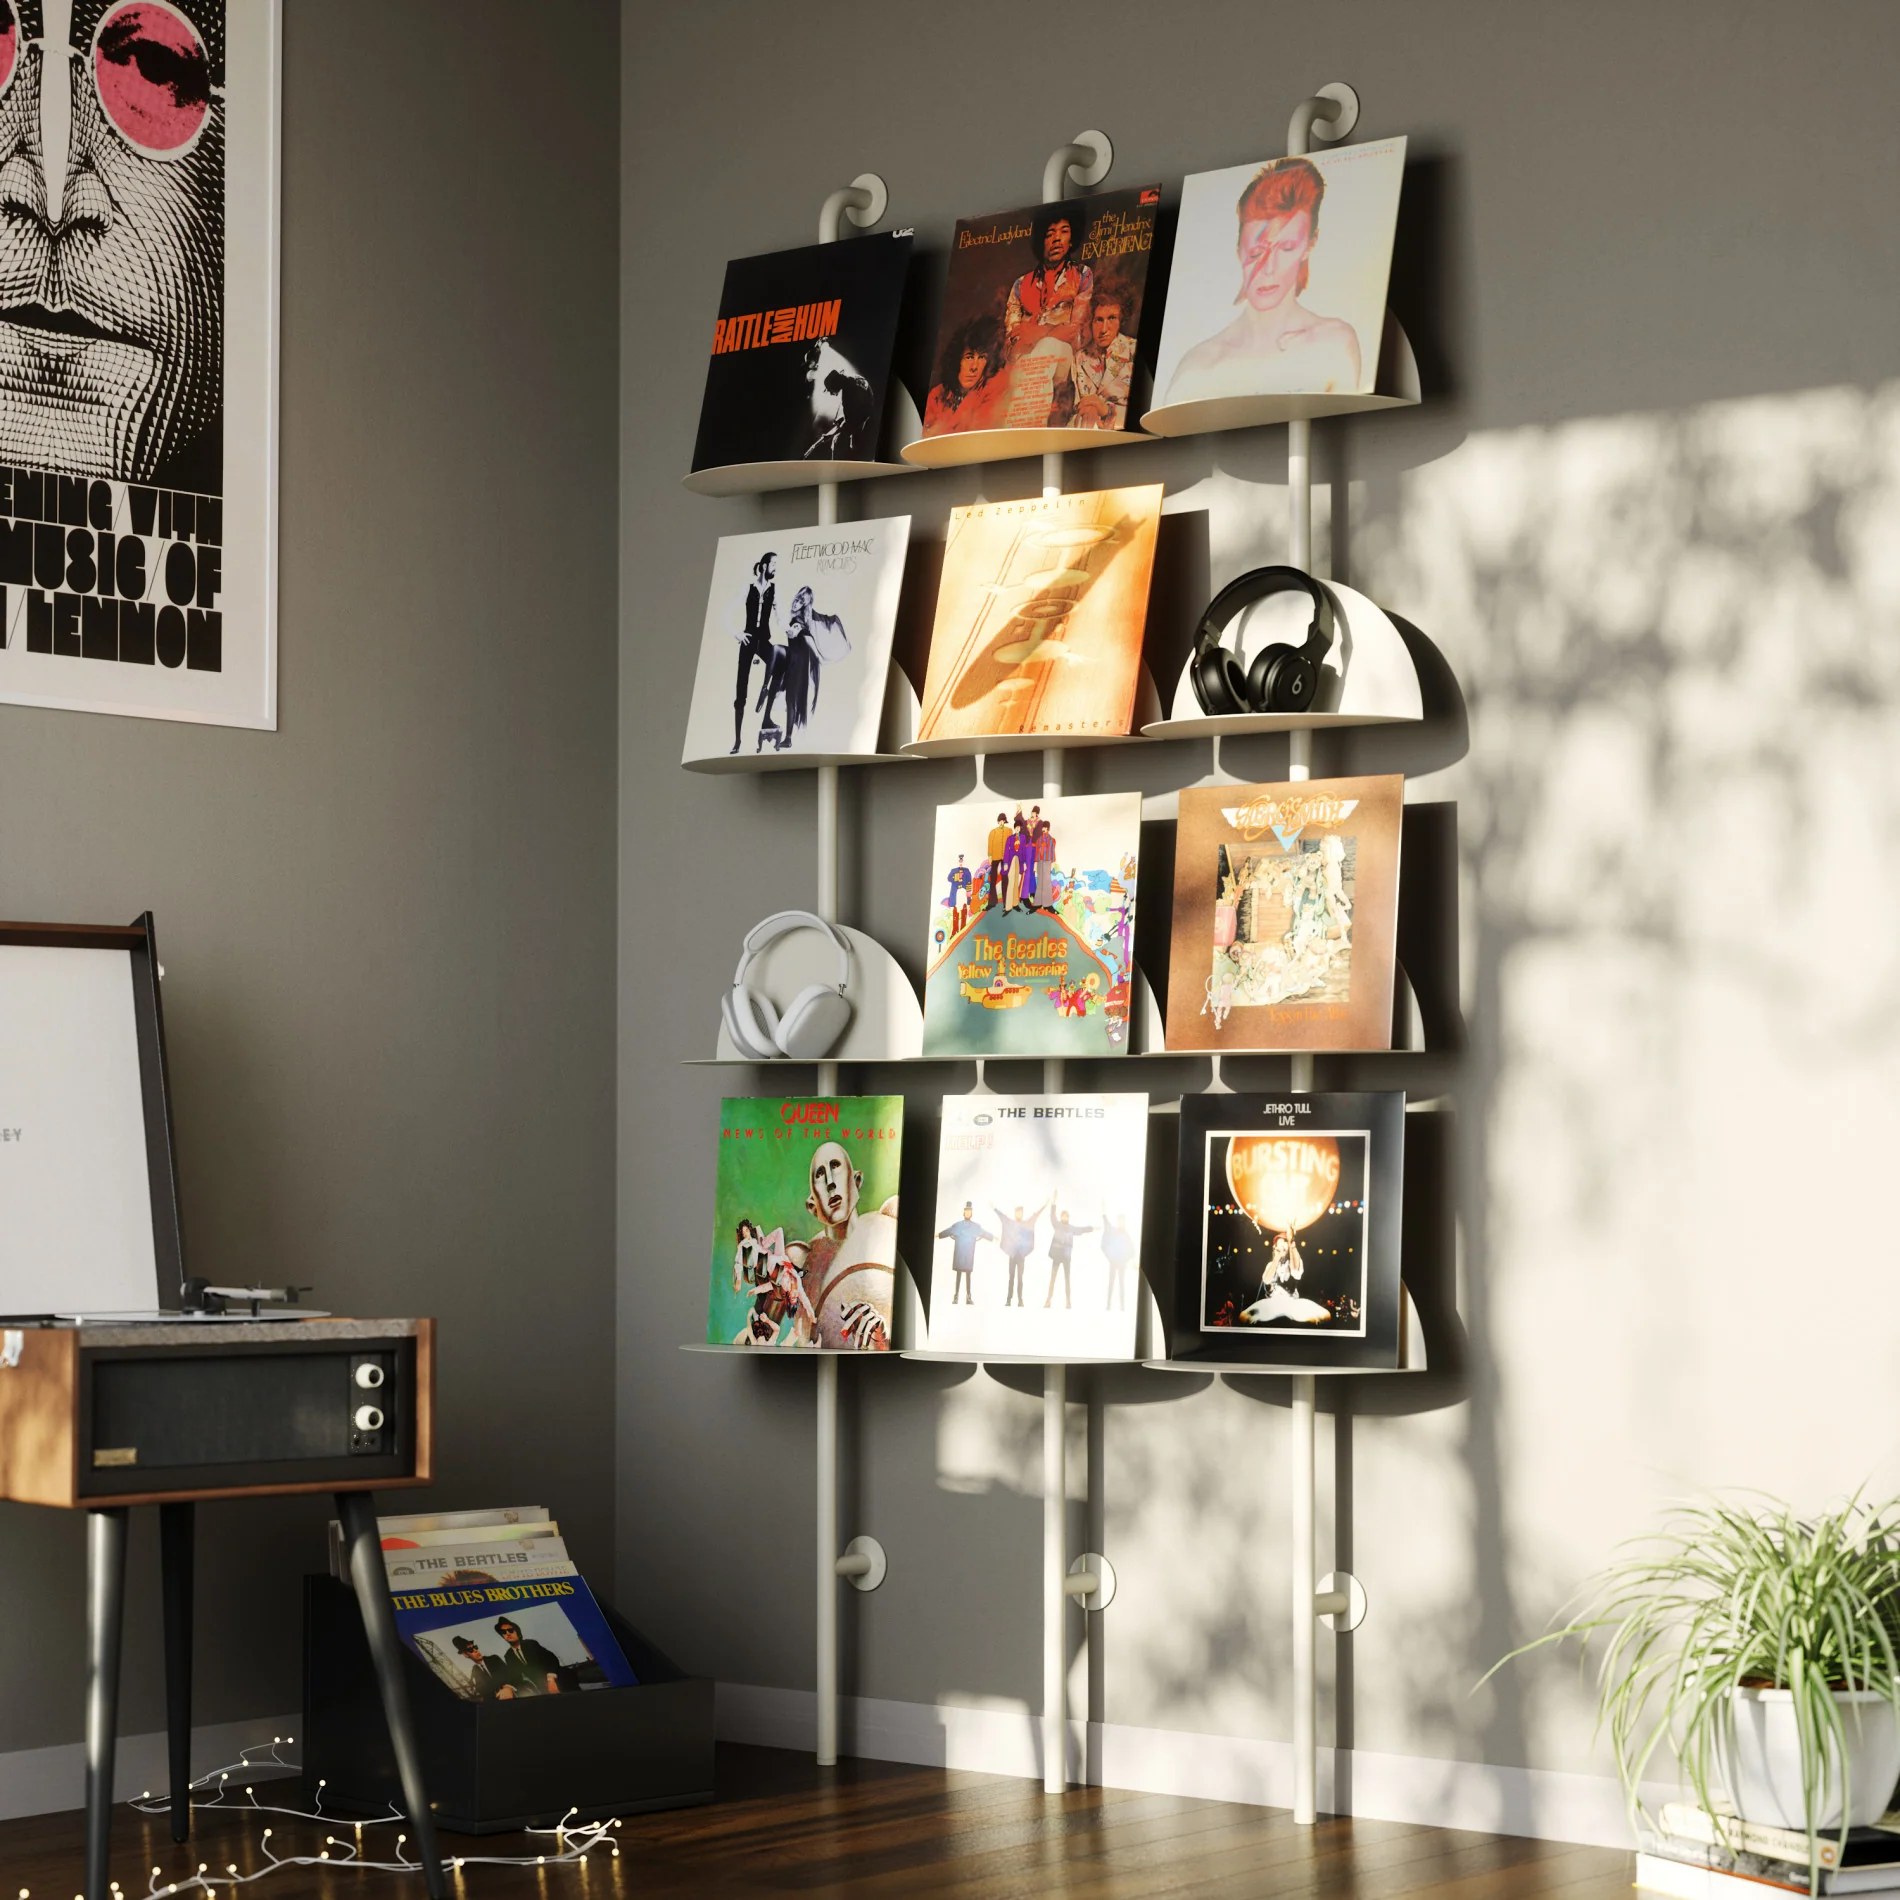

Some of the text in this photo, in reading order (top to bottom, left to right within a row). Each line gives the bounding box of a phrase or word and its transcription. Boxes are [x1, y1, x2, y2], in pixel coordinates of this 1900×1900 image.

[892, 227, 914, 239] U2
[711, 299, 842, 355] RATTLE AND HUM
[955, 510, 984, 520] Led
[791, 538, 875, 564] FLEETWOOD MAC
[0, 517, 222, 609] MUSIC OF
[26, 588, 222, 673] LENNON
[973, 931, 1068, 961] The Beatles
[958, 959, 1068, 979] Yellow Submarine
[780, 1102, 839, 1124] QUEEN
[997, 1107, 1105, 1119] THE BEATLES
[1262, 1103, 1312, 1114] JETHRO TULL
[1278, 1115, 1295, 1126] LIVE
[0, 1128, 22, 1142] EY
[723, 1127, 896, 1140] NEWS OF THE WORLD
[1232, 1140, 1340, 1182] BURSTING
[415, 1557, 448, 1570] THE
[454, 1553, 528, 1567] BEATLES
[391, 1581, 575, 1610] THE BLUES BROTHERS
